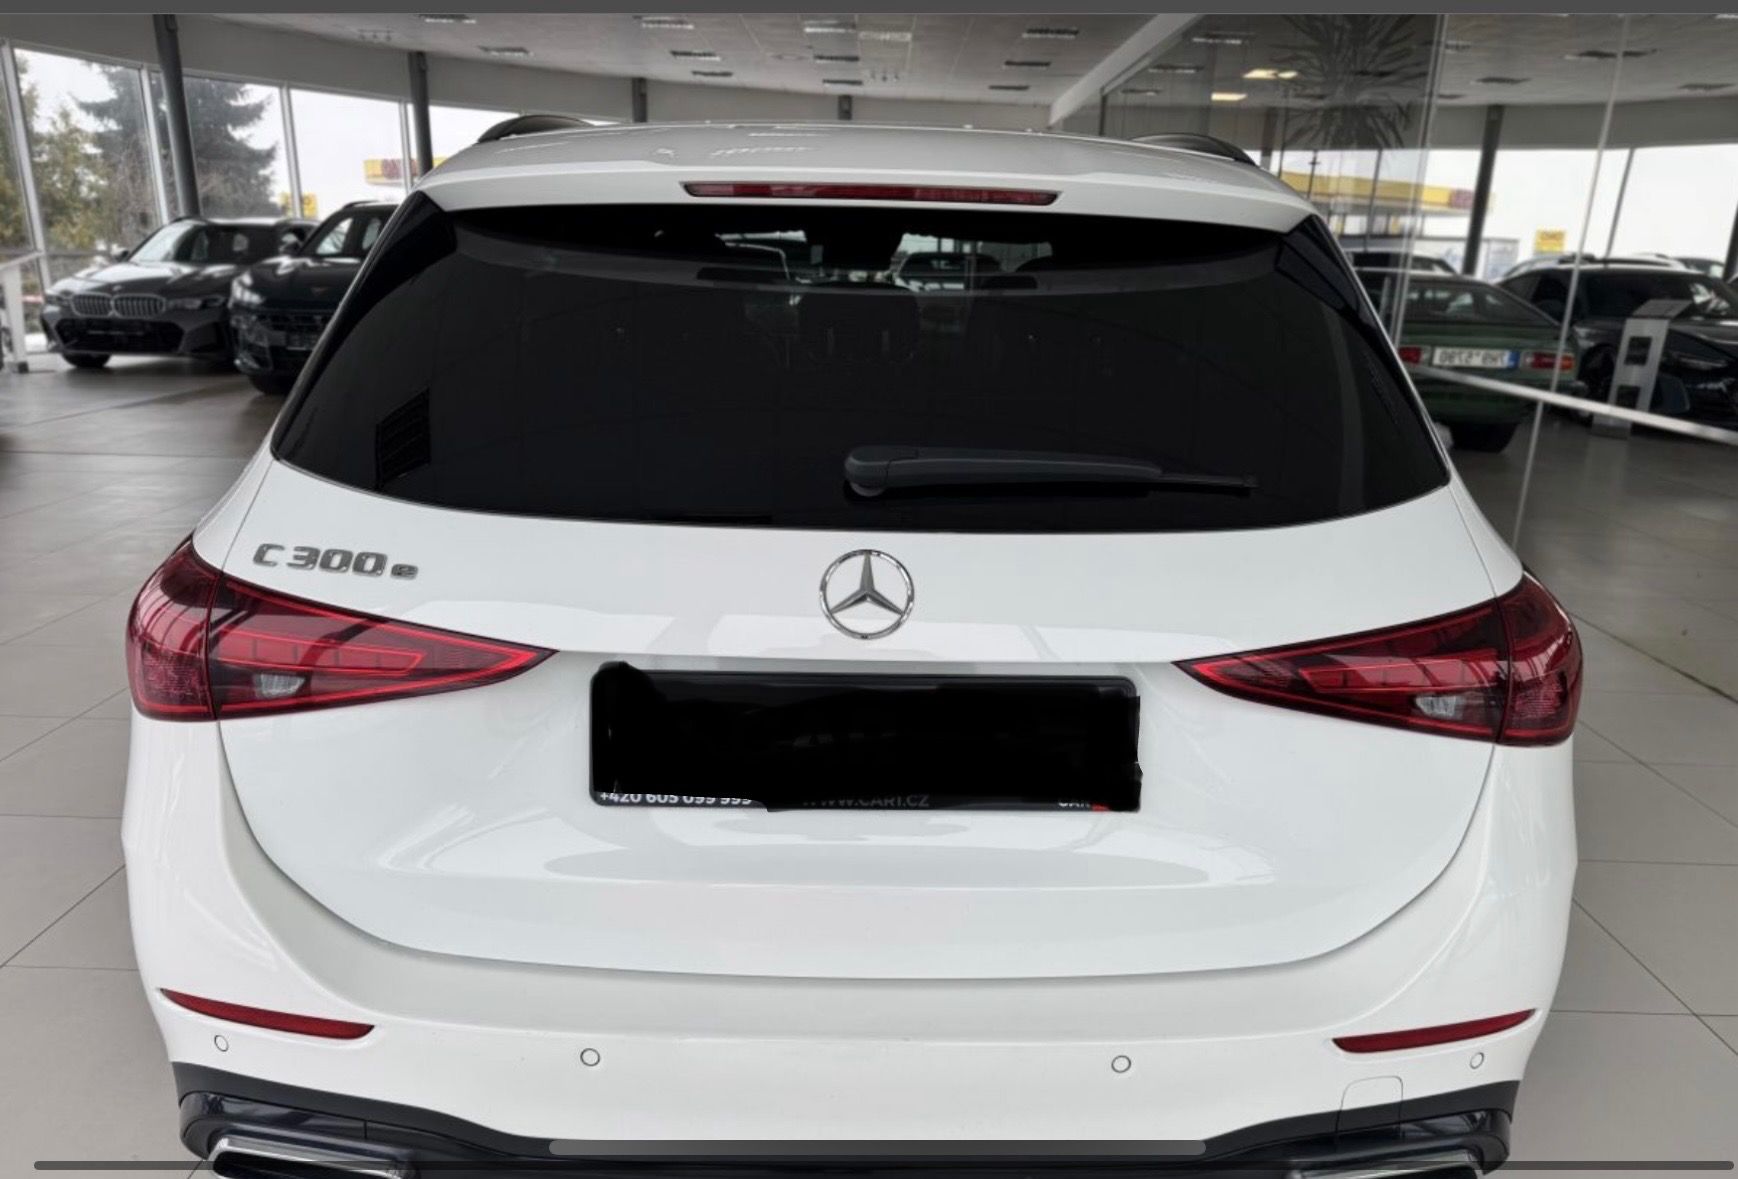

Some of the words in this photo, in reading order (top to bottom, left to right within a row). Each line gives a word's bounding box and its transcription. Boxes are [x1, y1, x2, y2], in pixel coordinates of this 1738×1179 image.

[253, 543, 285, 567] C
[286, 546, 388, 577] 300
[390, 563, 419, 580] e
[600, 792, 641, 803] +420
[646, 793, 679, 804] 605
